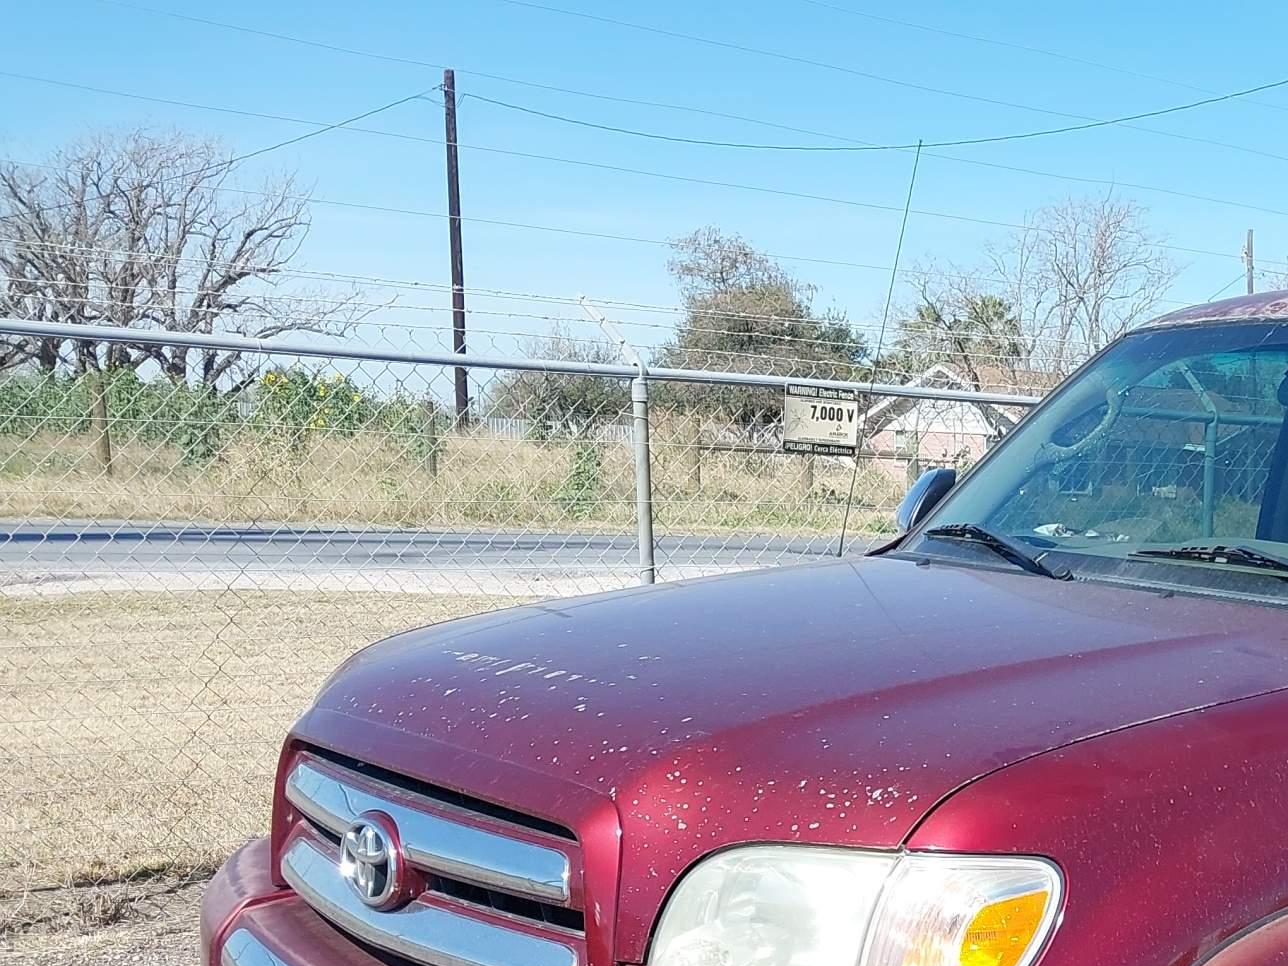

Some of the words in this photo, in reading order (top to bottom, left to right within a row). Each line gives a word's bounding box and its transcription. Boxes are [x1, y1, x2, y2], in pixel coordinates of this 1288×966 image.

[788, 385, 818, 397] WARNING!
[819, 388, 838, 399] Electric
[838, 390, 854, 400] Fence
[810, 405, 843, 422] 7,000
[847, 408, 855, 423] V
[814, 445, 829, 453] Cerca
